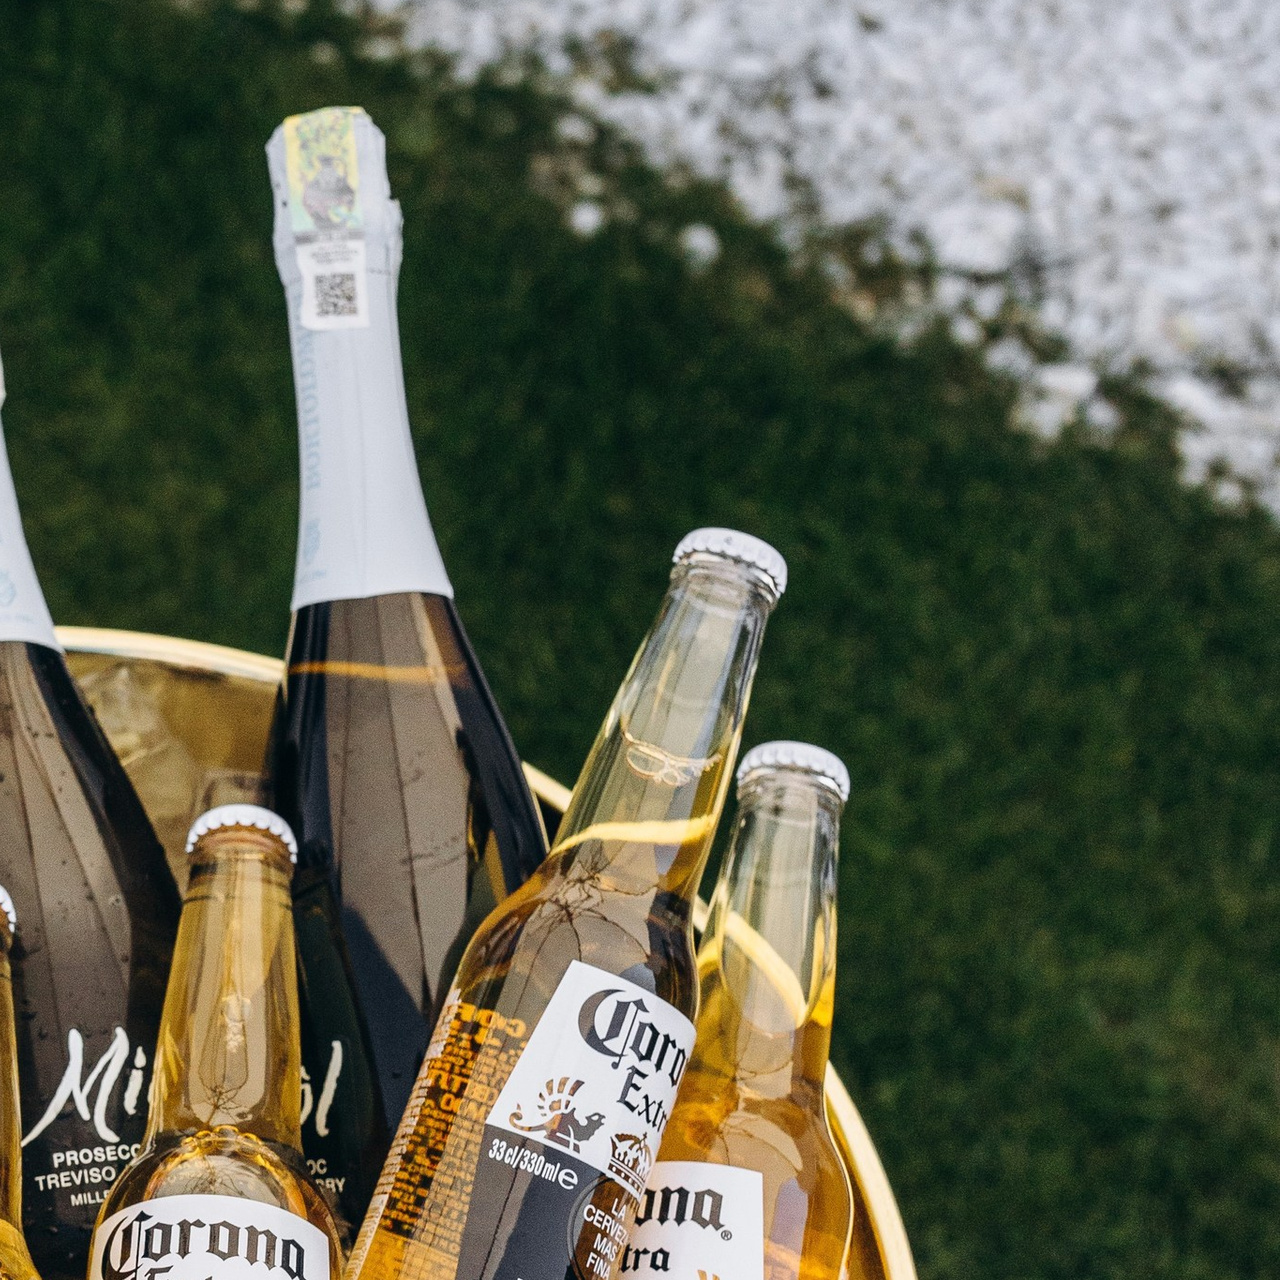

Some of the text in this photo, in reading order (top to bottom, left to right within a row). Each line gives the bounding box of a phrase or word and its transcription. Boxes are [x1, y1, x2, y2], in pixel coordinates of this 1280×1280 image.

[578, 989, 688, 1088] Coro
[617, 1065, 667, 1131] Extr
[52, 1143, 141, 1168] PROSECC
[34, 1165, 116, 1191] TREVISO
[611, 1198, 627, 1221] LA
[634, 1185, 725, 1232] ona
[584, 1204, 629, 1245] CERVEZ
[594, 1233, 618, 1261] MAS
[621, 1244, 670, 1273] tra
[586, 1252, 611, 1280] FINA
